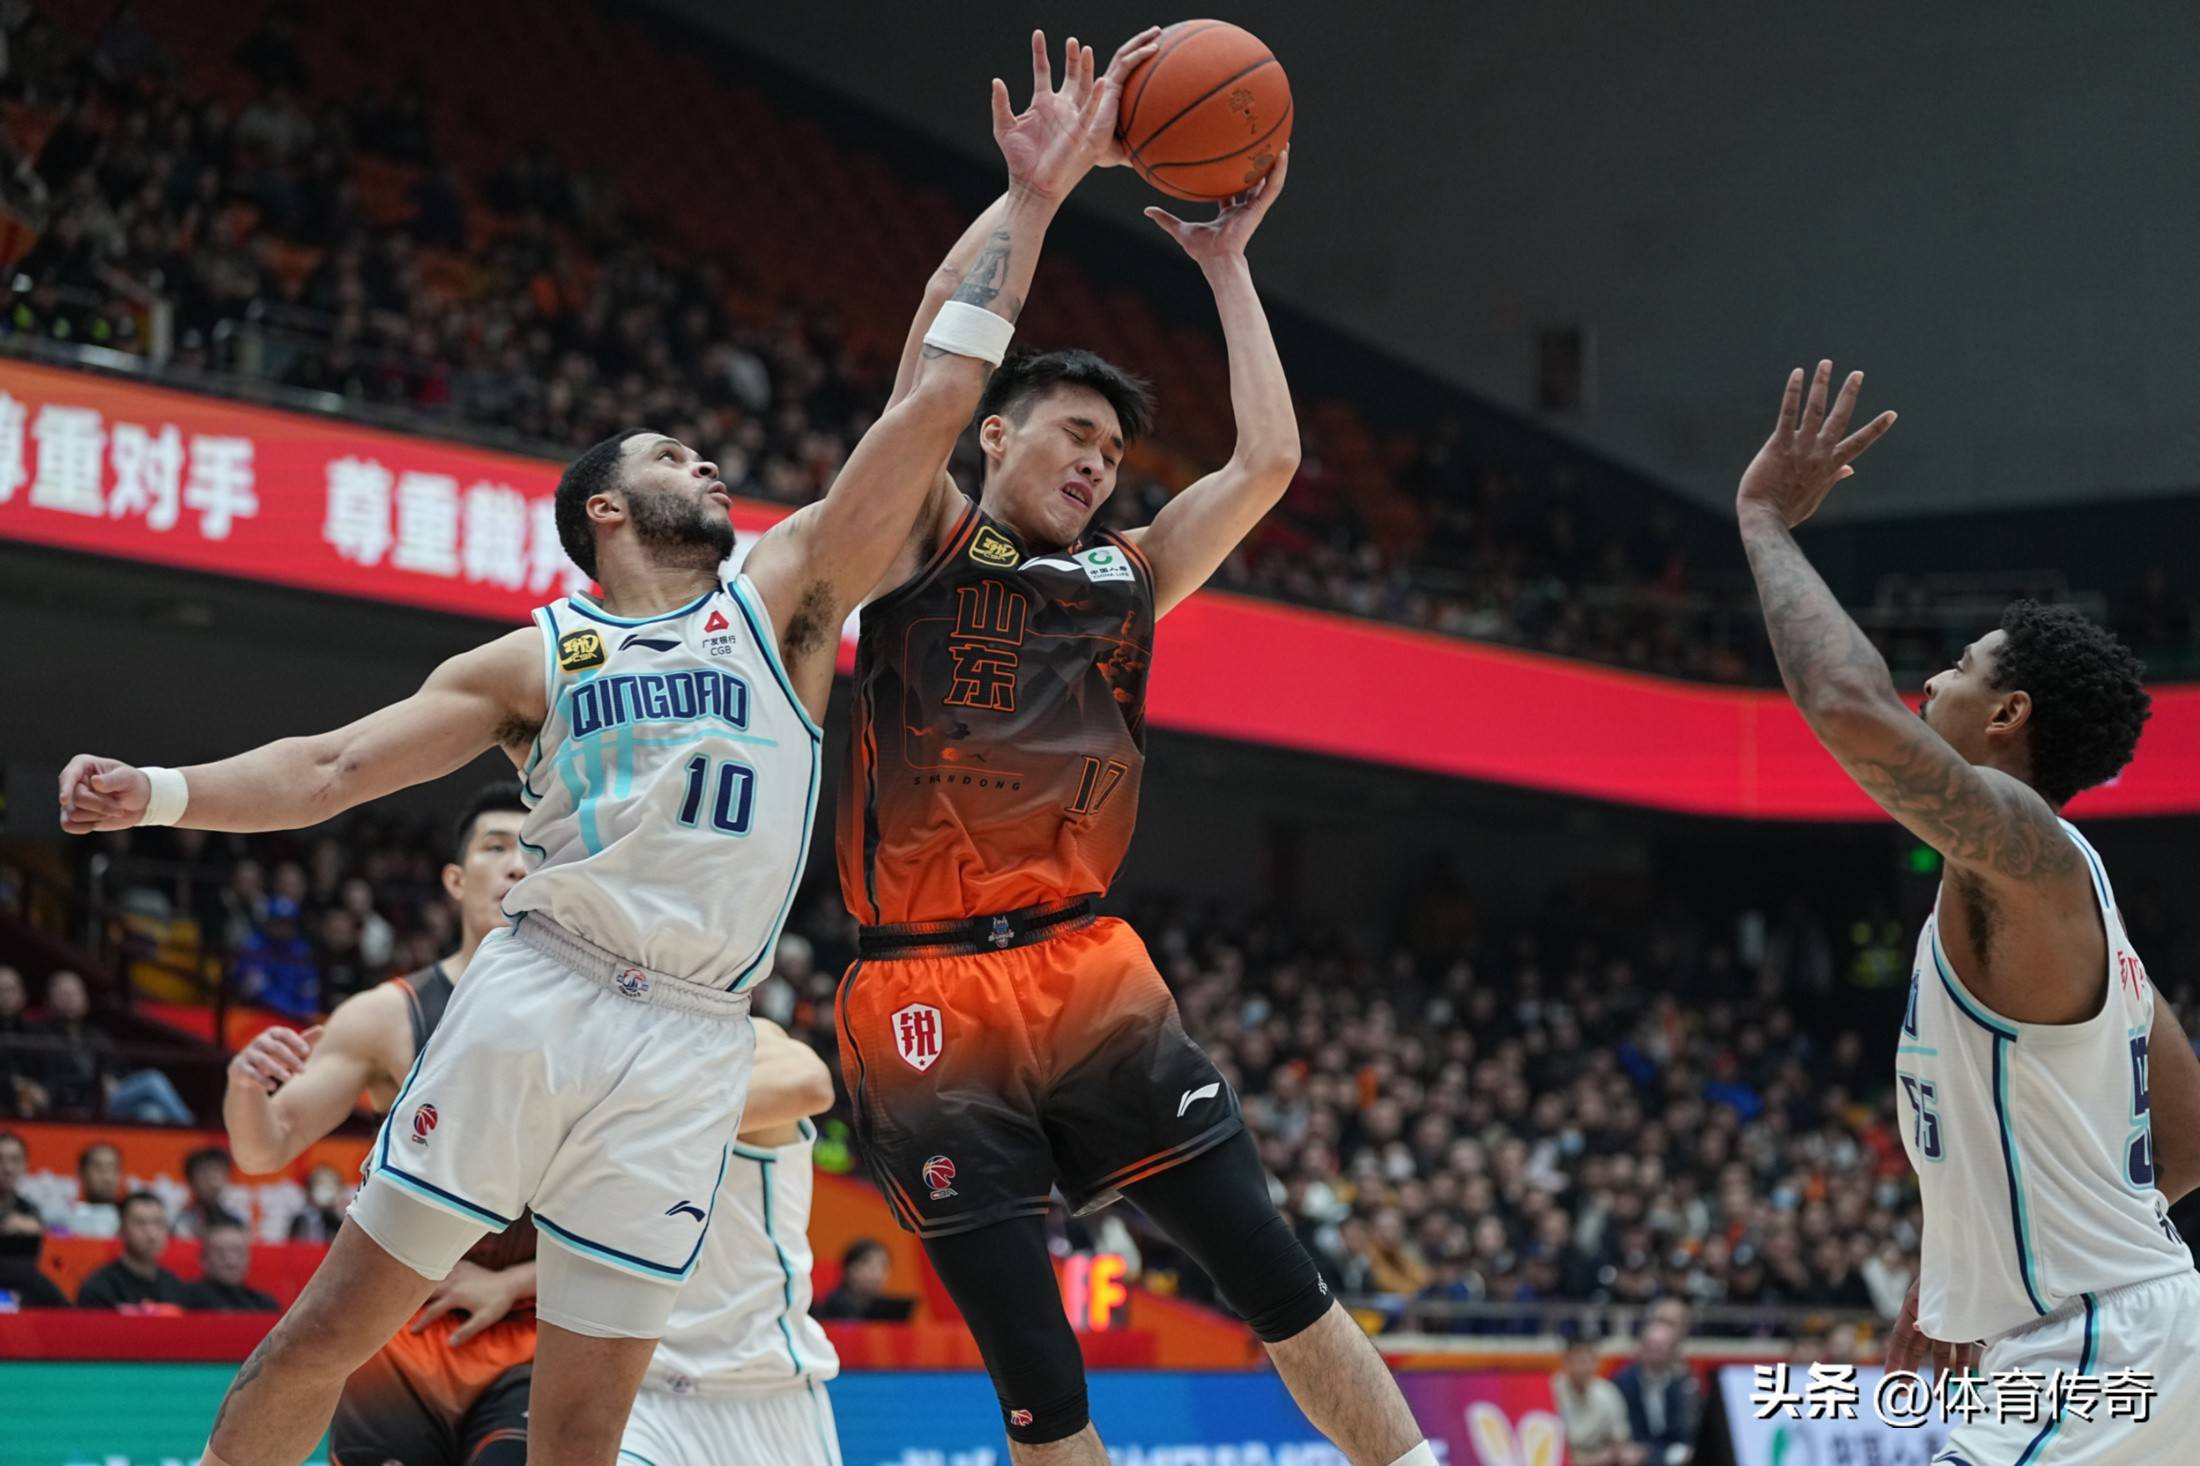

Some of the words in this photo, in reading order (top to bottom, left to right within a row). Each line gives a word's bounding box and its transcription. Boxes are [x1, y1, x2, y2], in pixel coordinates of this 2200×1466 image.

[710, 645, 731, 656] CGB
[944, 579, 1027, 712] 山东
[571, 671, 749, 741] QINGDAO
[678, 753, 758, 837] 10
[1064, 754, 1129, 815] 17
